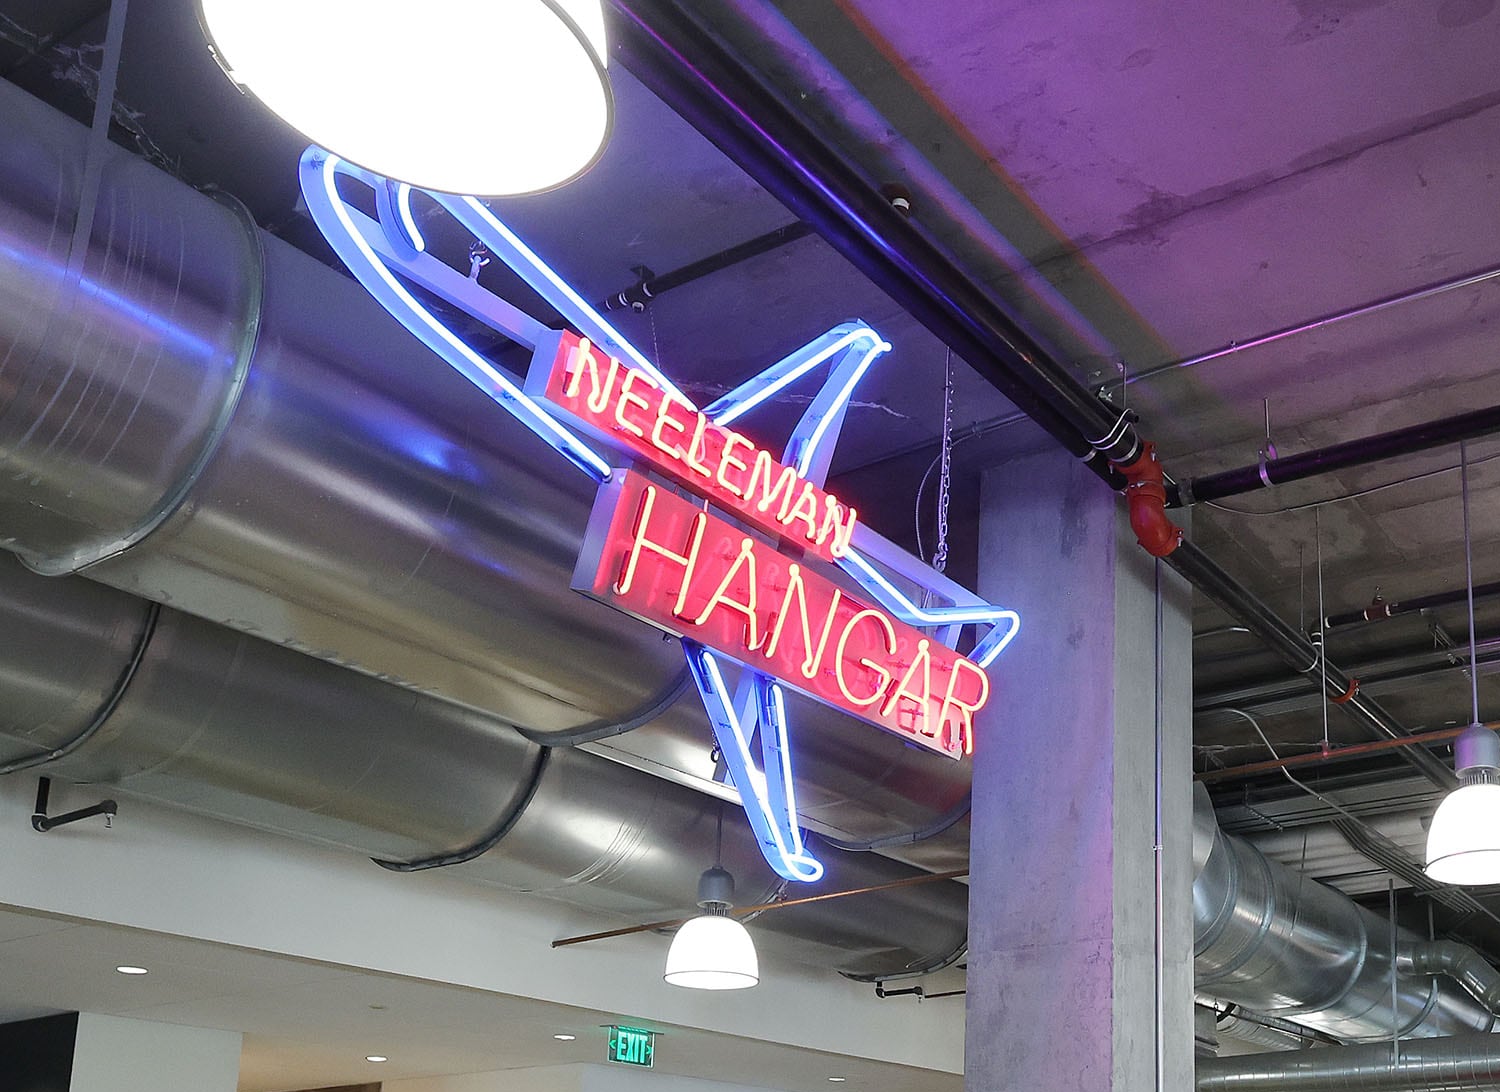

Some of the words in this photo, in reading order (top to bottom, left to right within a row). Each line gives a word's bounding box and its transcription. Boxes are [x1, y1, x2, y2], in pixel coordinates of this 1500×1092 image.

[567, 337, 858, 558] NEELEMAN
[612, 486, 989, 755] HANGAR
[616, 1031, 648, 1064] EXIT
